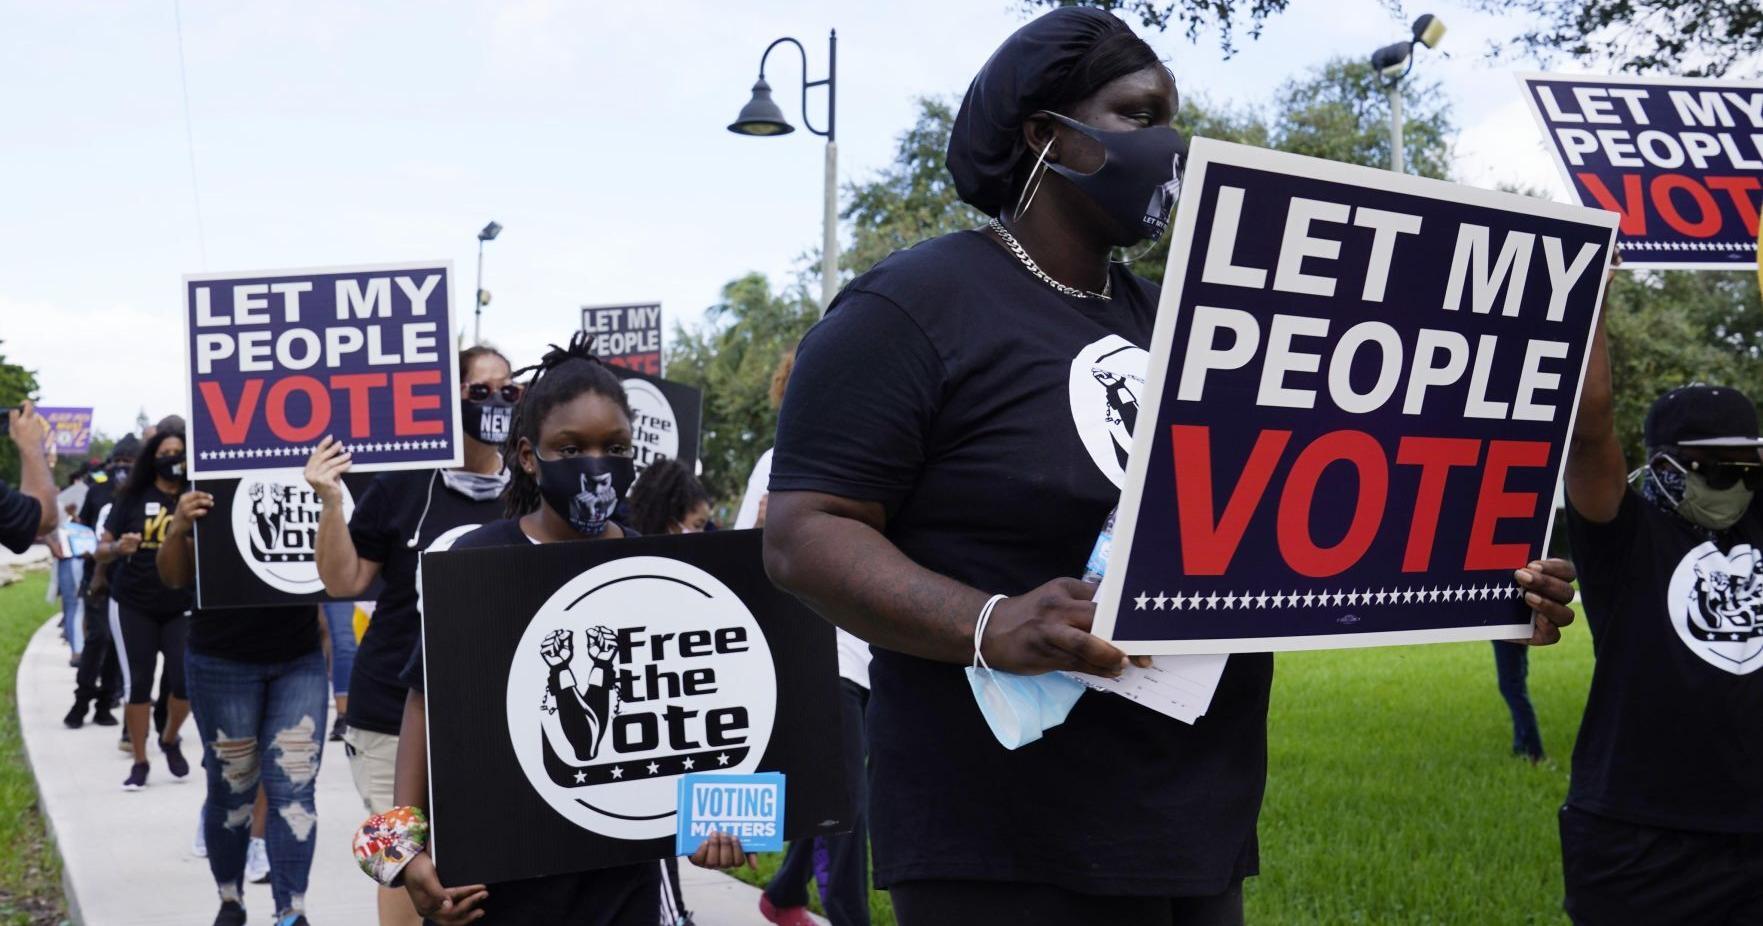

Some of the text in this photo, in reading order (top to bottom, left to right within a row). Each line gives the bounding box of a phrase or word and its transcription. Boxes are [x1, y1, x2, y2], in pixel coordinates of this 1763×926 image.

[1535, 85, 1763, 128] LET MY
[1576, 172, 1763, 238] VOT
[1201, 185, 1601, 322] LET MY
[195, 274, 442, 327] LET MY
[583, 306, 660, 334] LET MY
[196, 322, 439, 374] PEOPLE
[1177, 304, 1569, 422] PEOPLE
[199, 370, 444, 445] VOTE
[480, 413, 512, 433] NEW
[284, 506, 321, 524] th
[1171, 424, 1552, 578] VOTE
[617, 626, 749, 665] Free
[615, 664, 718, 703] the
[696, 787, 773, 817] VOTING
[690, 822, 777, 837] MATTERS
